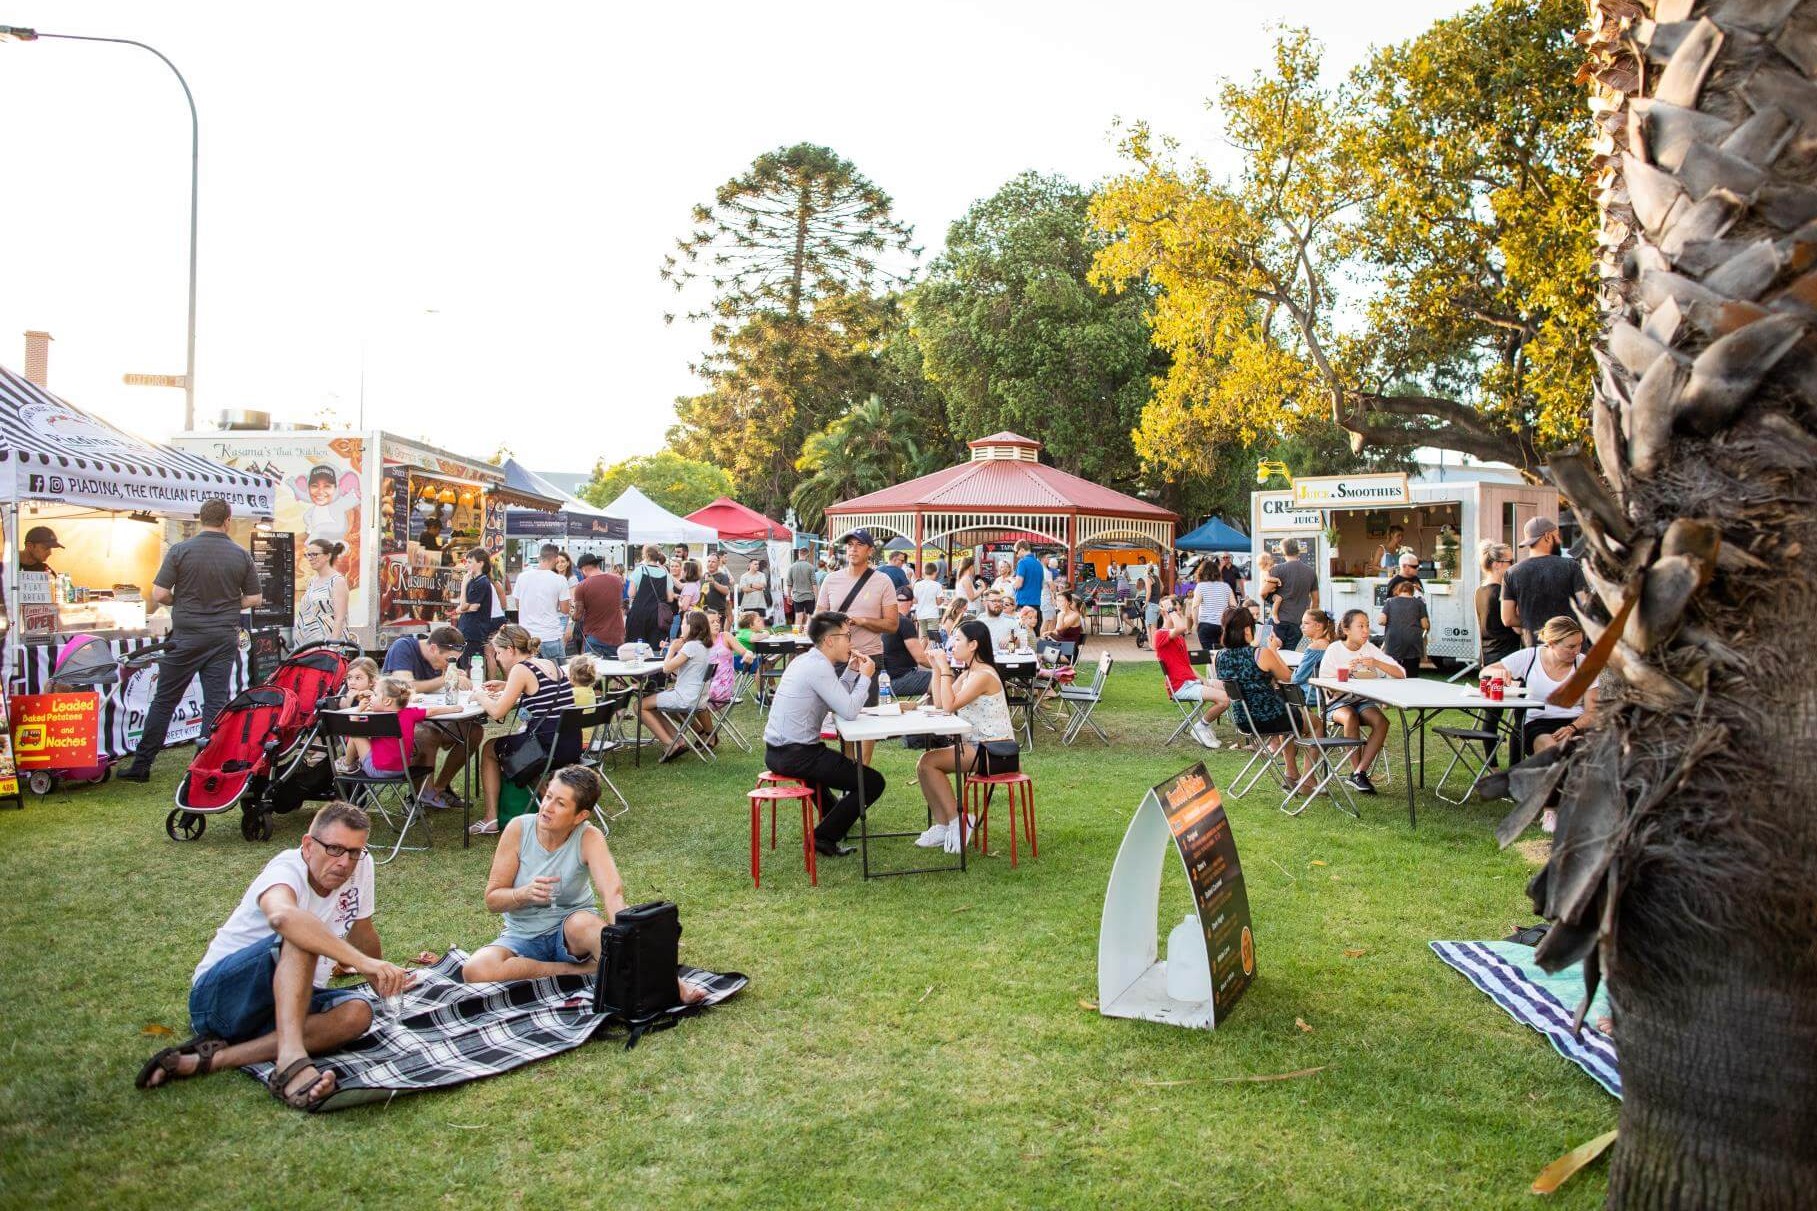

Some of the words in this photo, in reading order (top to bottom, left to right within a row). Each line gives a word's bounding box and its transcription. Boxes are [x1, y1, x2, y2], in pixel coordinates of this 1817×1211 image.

[68, 478, 123, 499] PIADINA,
[124, 484, 147, 498] THE
[149, 485, 188, 502] ITALIAN
[1262, 500, 1316, 514] CRU
[1294, 515, 1320, 524] JUICE
[26, 613, 56, 633] OPEN
[52, 700, 94, 712] Loaded
[22, 713, 46, 722] Baked
[47, 712, 83, 722] Potatoes
[166, 729, 184, 740] REET
[46, 736, 87, 748] Nachos
